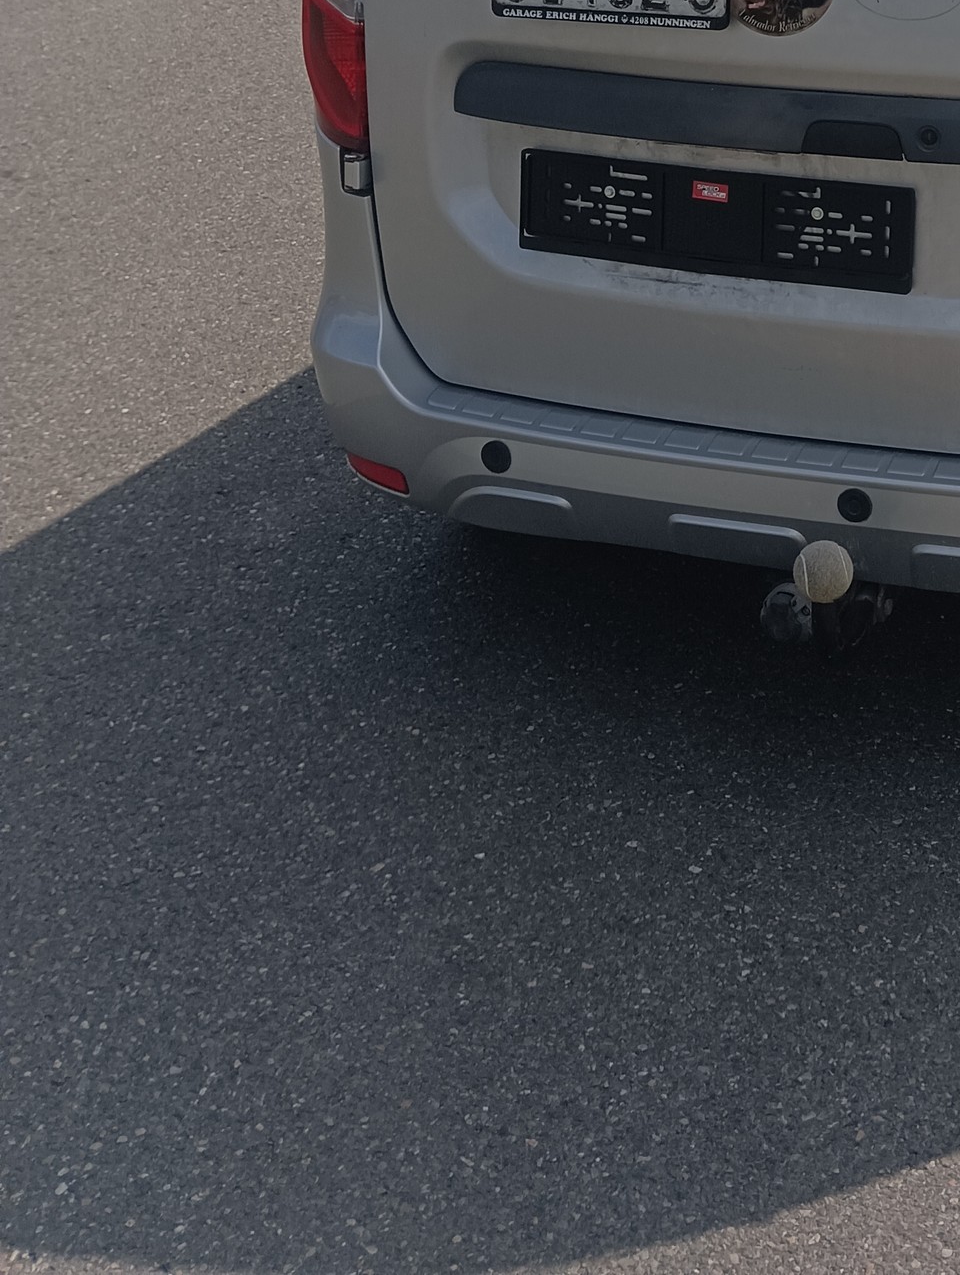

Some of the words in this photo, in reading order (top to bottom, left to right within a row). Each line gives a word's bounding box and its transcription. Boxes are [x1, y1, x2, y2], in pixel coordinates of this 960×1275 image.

[503, 8, 542, 18] GARAGE
[546, 11, 576, 21] ERICH
[579, 12, 618, 23] HÄNGGI
[630, 16, 649, 25] 4208
[650, 17, 711, 29] NUNNINGEN
